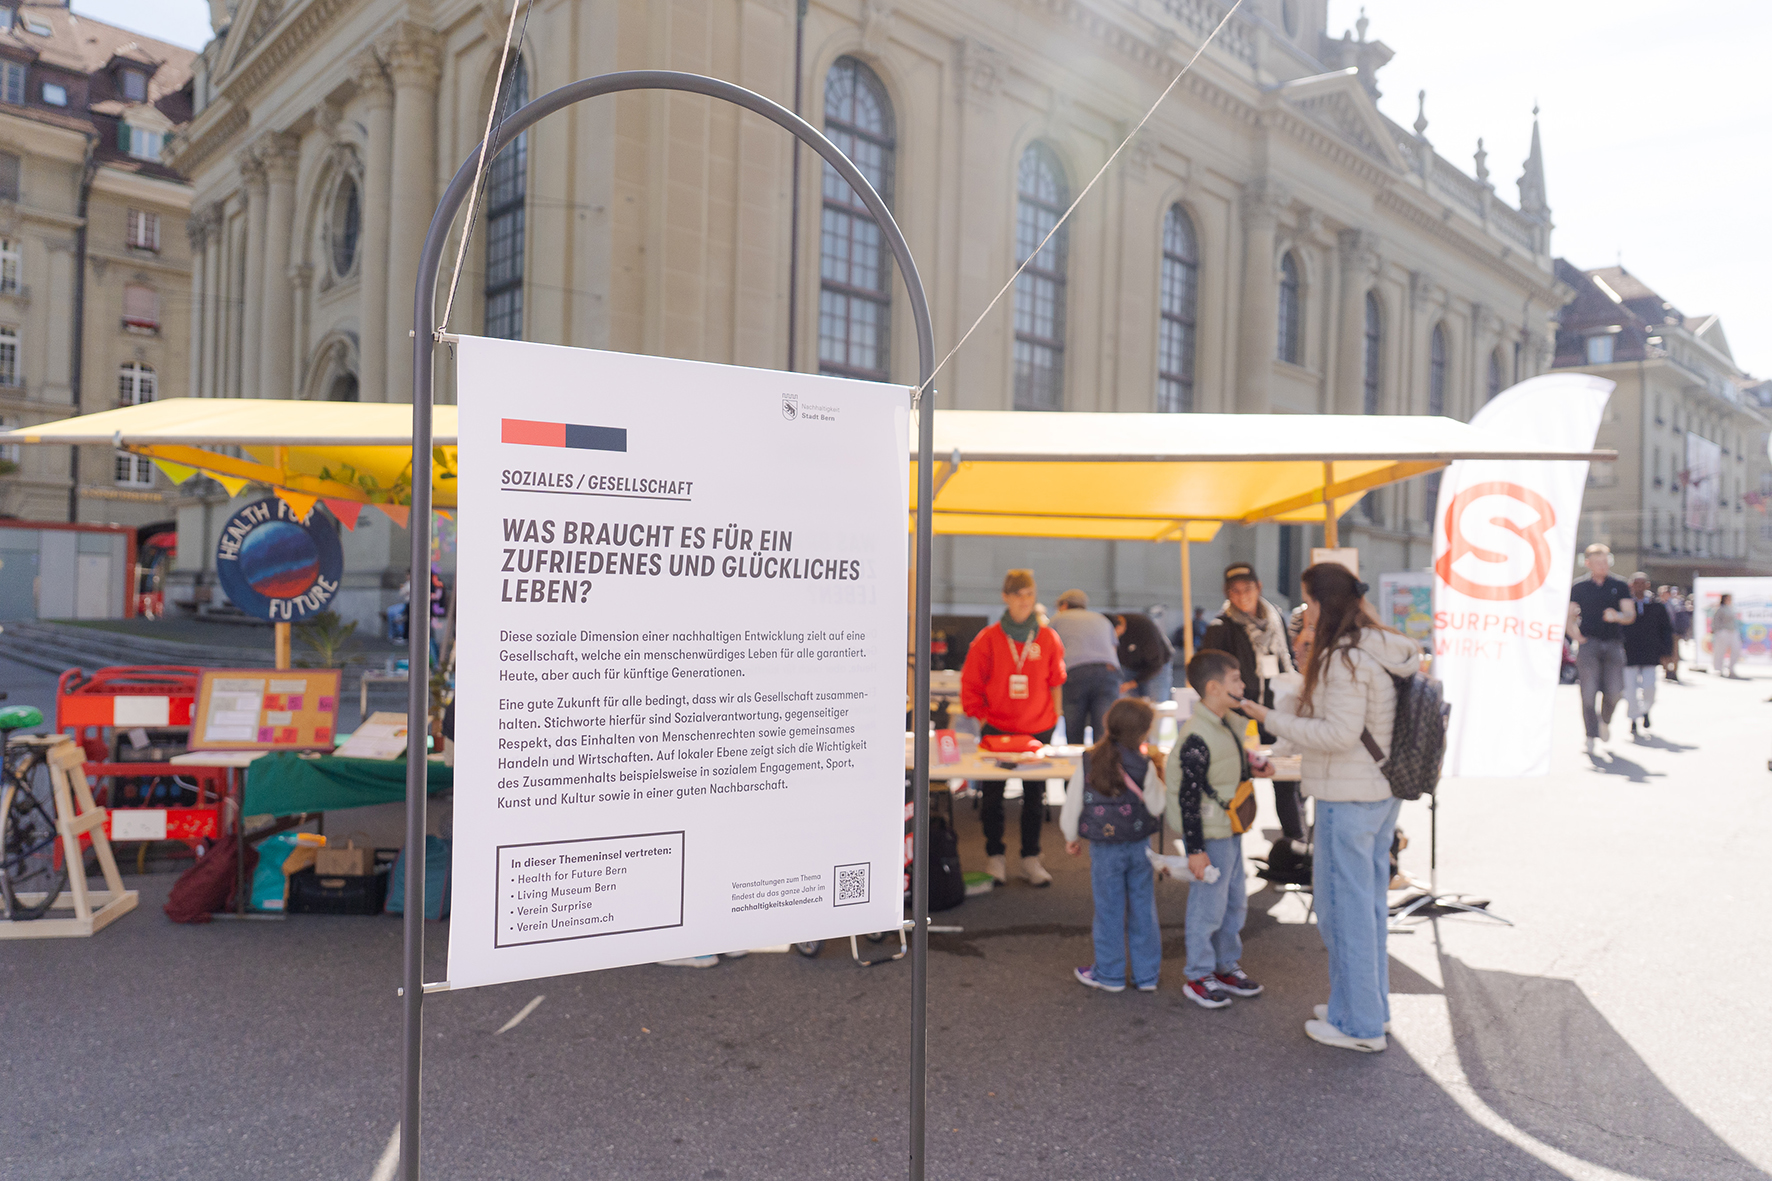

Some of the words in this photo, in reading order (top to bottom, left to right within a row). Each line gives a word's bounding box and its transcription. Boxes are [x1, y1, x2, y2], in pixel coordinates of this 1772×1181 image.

[801, 412, 819, 420] Stadt
[501, 469, 574, 489] SOZIALES
[588, 475, 694, 495] GESELLSCHAFT
[218, 501, 270, 561] HEALTH
[503, 518, 556, 544] WAS
[563, 521, 675, 548] BRAUCHT
[679, 526, 706, 550] ES
[712, 522, 753, 551] FÜR
[759, 530, 793, 554] EIN
[501, 548, 662, 576] ZUFRIEDENES
[669, 554, 715, 577] UND
[722, 551, 860, 581] GLÜCKLICHES
[269, 574, 338, 620] FUTURE
[501, 578, 592, 604] LEBEN?
[500, 630, 533, 642] Diese
[536, 630, 577, 642] soziale
[580, 630, 639, 642] Dimension
[641, 630, 670, 642] einer
[672, 630, 742, 645] nachhaltigen
[744, 630, 805, 644] Entwicklung
[807, 630, 827, 641] zielt
[828, 630, 845, 641] auf
[846, 630, 866, 641] eine
[1434, 611, 1563, 643] SURPRISE
[499, 649, 578, 663] Gesellschaft,
[581, 649, 621, 661] welche
[623, 649, 641, 661] ein
[643, 648, 746, 663] menschenwürdiges
[748, 648, 778, 659] Leben
[780, 647, 794, 659] für
[796, 647, 815, 659] alle
[816, 647, 867, 661] garantiert.
[1433, 638, 1507, 660] WIRKT
[499, 669, 538, 683] Heute,
[541, 669, 569, 681] aber
[572, 668, 601, 681] auch
[604, 668, 621, 680] für
[623, 667, 669, 682] künftige
[671, 666, 745, 679] Generationen.
[499, 698, 524, 710] Eine
[527, 699, 554, 713] gute
[557, 696, 601, 709] Zukunft
[603, 695, 620, 708] für
[621, 695, 643, 707] alle
[645, 694, 690, 709] bedingt,
[691, 693, 717, 705] dass
[718, 693, 735, 704] wir
[736, 692, 752, 704] als
[754, 690, 814, 703] Gesellschaft
[815, 691, 868, 701] zusammen-
[498, 717, 541, 730] halten.
[544, 716, 606, 729] Stichworte
[609, 713, 646, 726] hierfür
[648, 712, 672, 725] sind
[674, 710, 783, 724] Sozialverantwortung,
[784, 707, 849, 722] gegenseitiger
[498, 736, 552, 752] Respekt,
[555, 735, 578, 748] das
[581, 733, 635, 746] Einhalten
[638, 734, 659, 744] von
[662, 728, 756, 742] Menschenrechten
[758, 726, 787, 738] sowie
[788, 724, 855, 740] gemeinsames
[498, 755, 549, 770] Handeln
[552, 754, 575, 767] und
[578, 751, 654, 765] Wirtschaften.
[656, 749, 675, 761] Auf
[677, 747, 714, 760] lokaler
[716, 746, 748, 758] Ebene
[750, 745, 774, 759] zeigt
[776, 743, 796, 755] sich
[798, 742, 814, 754] die
[815, 739, 867, 754] Wichtigkeit
[497, 777, 520, 790] des
[522, 771, 617, 788] Zusammenhalts
[619, 767, 698, 783] beispielsweise
[700, 766, 710, 777] in
[712, 763, 757, 777] sozialem
[760, 760, 824, 776] Engagement,
[825, 758, 855, 771] Sport,
[497, 796, 531, 809] Kunst
[534, 793, 557, 807] und
[561, 792, 596, 805] Kultur
[598, 789, 631, 802] sowie
[633, 788, 643, 800] in
[646, 787, 674, 799] einer
[676, 786, 707, 800] guten
[709, 778, 788, 794] Nachbarschaft.
[511, 859, 522, 869] In
[523, 857, 557, 868] dieser
[558, 849, 622, 865] Themeninsel
[624, 847, 672, 858] vertreten:
[518, 872, 552, 884] Health
[554, 871, 569, 881] for
[571, 869, 603, 879] Future
[605, 866, 627, 876] Bern
[731, 878, 786, 890] Veranstaltungen
[786, 876, 800, 884] zum
[800, 874, 822, 882] Thema
[517, 889, 548, 901] Living
[551, 886, 592, 897] Museum
[594, 882, 617, 893] Bern
[731, 892, 755, 901] findest
[755, 890, 766, 899] du
[766, 889, 780, 898] das
[780, 888, 801, 898] ganze
[801, 885, 817, 894] Jahr
[817, 883, 826, 891] im
[516, 904, 549, 916] Verein
[551, 900, 593, 913] Surprise
[731, 895, 823, 913] nachhaltigkeitskalender.ch
[516, 920, 548, 932] Verein
[551, 912, 614, 929] Uneinsam.ch
